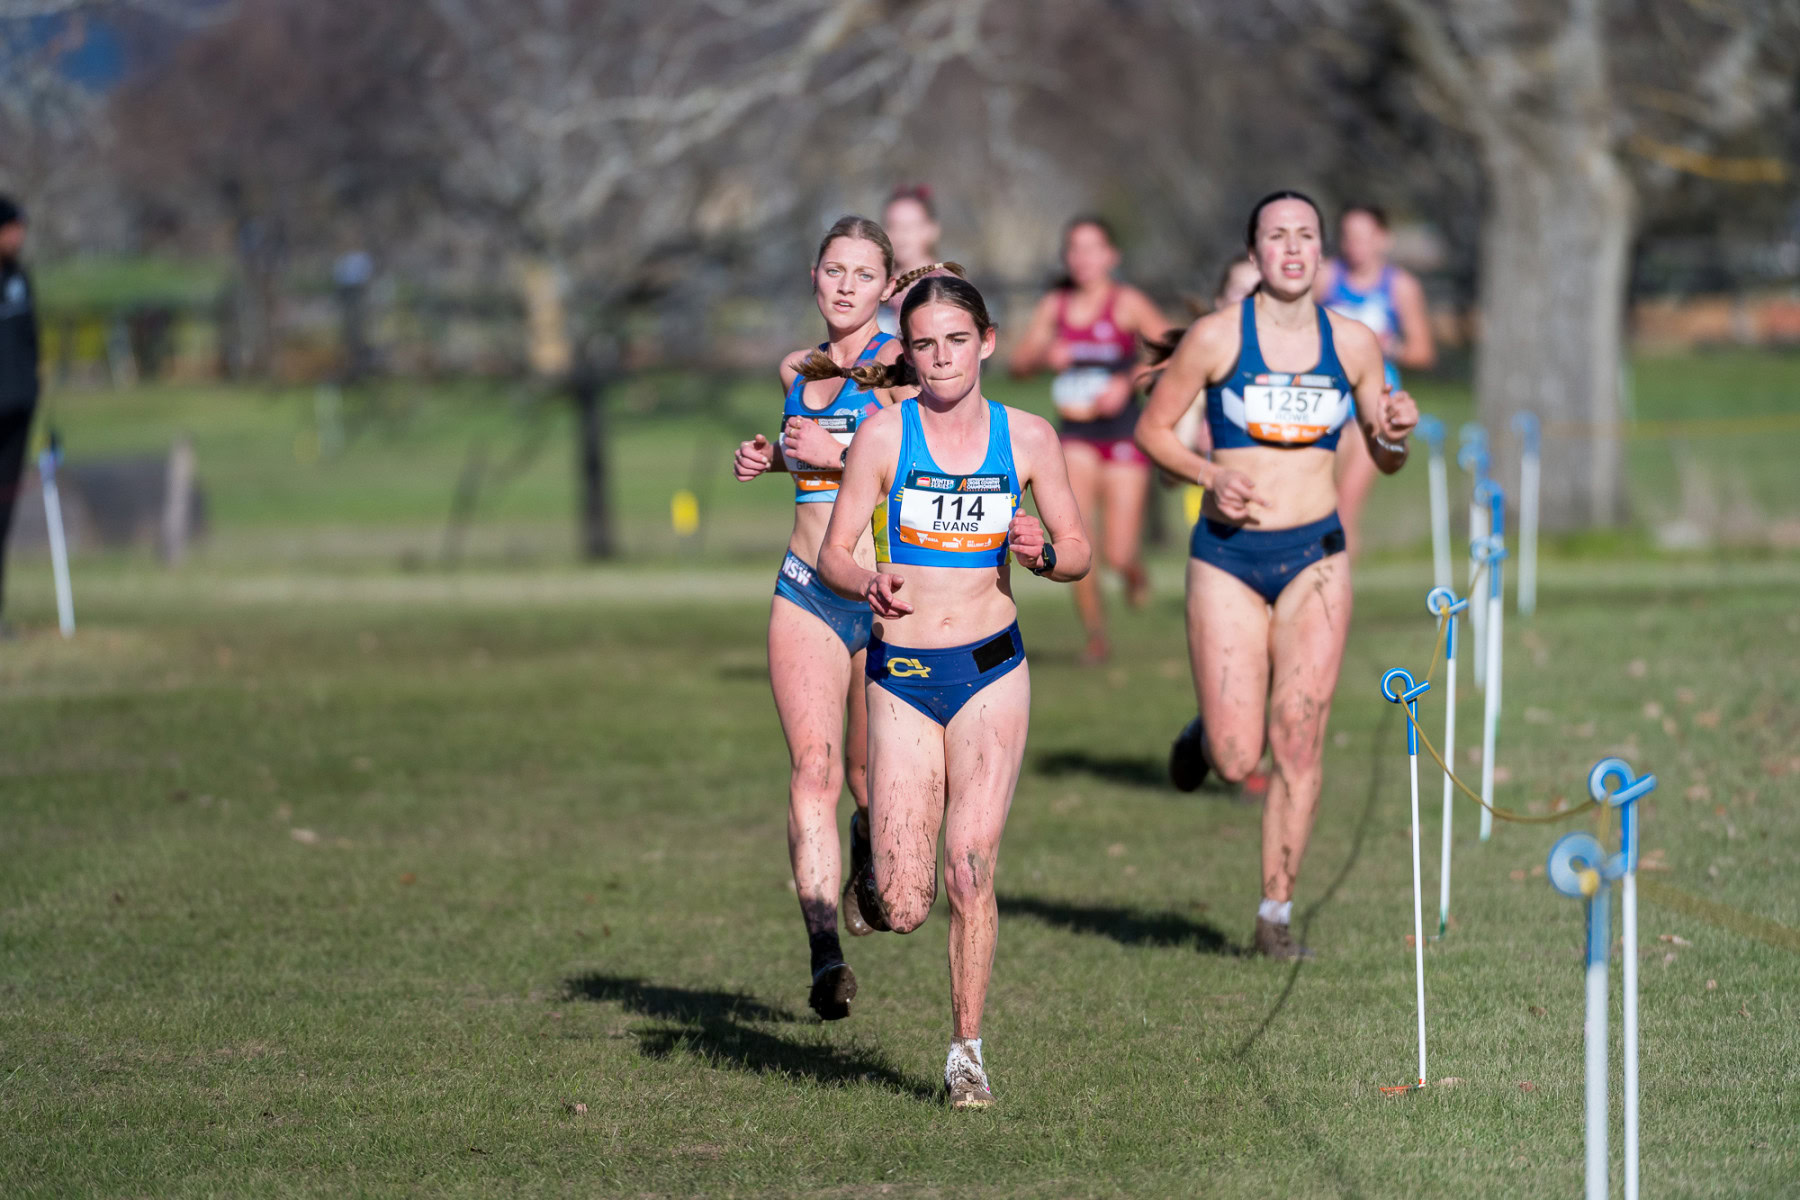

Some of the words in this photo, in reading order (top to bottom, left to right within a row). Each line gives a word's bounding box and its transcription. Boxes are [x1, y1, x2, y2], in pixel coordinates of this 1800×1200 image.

[1264, 390, 1323, 413] 1257
[932, 495, 985, 521] 114
[933, 521, 979, 532] EVANS
